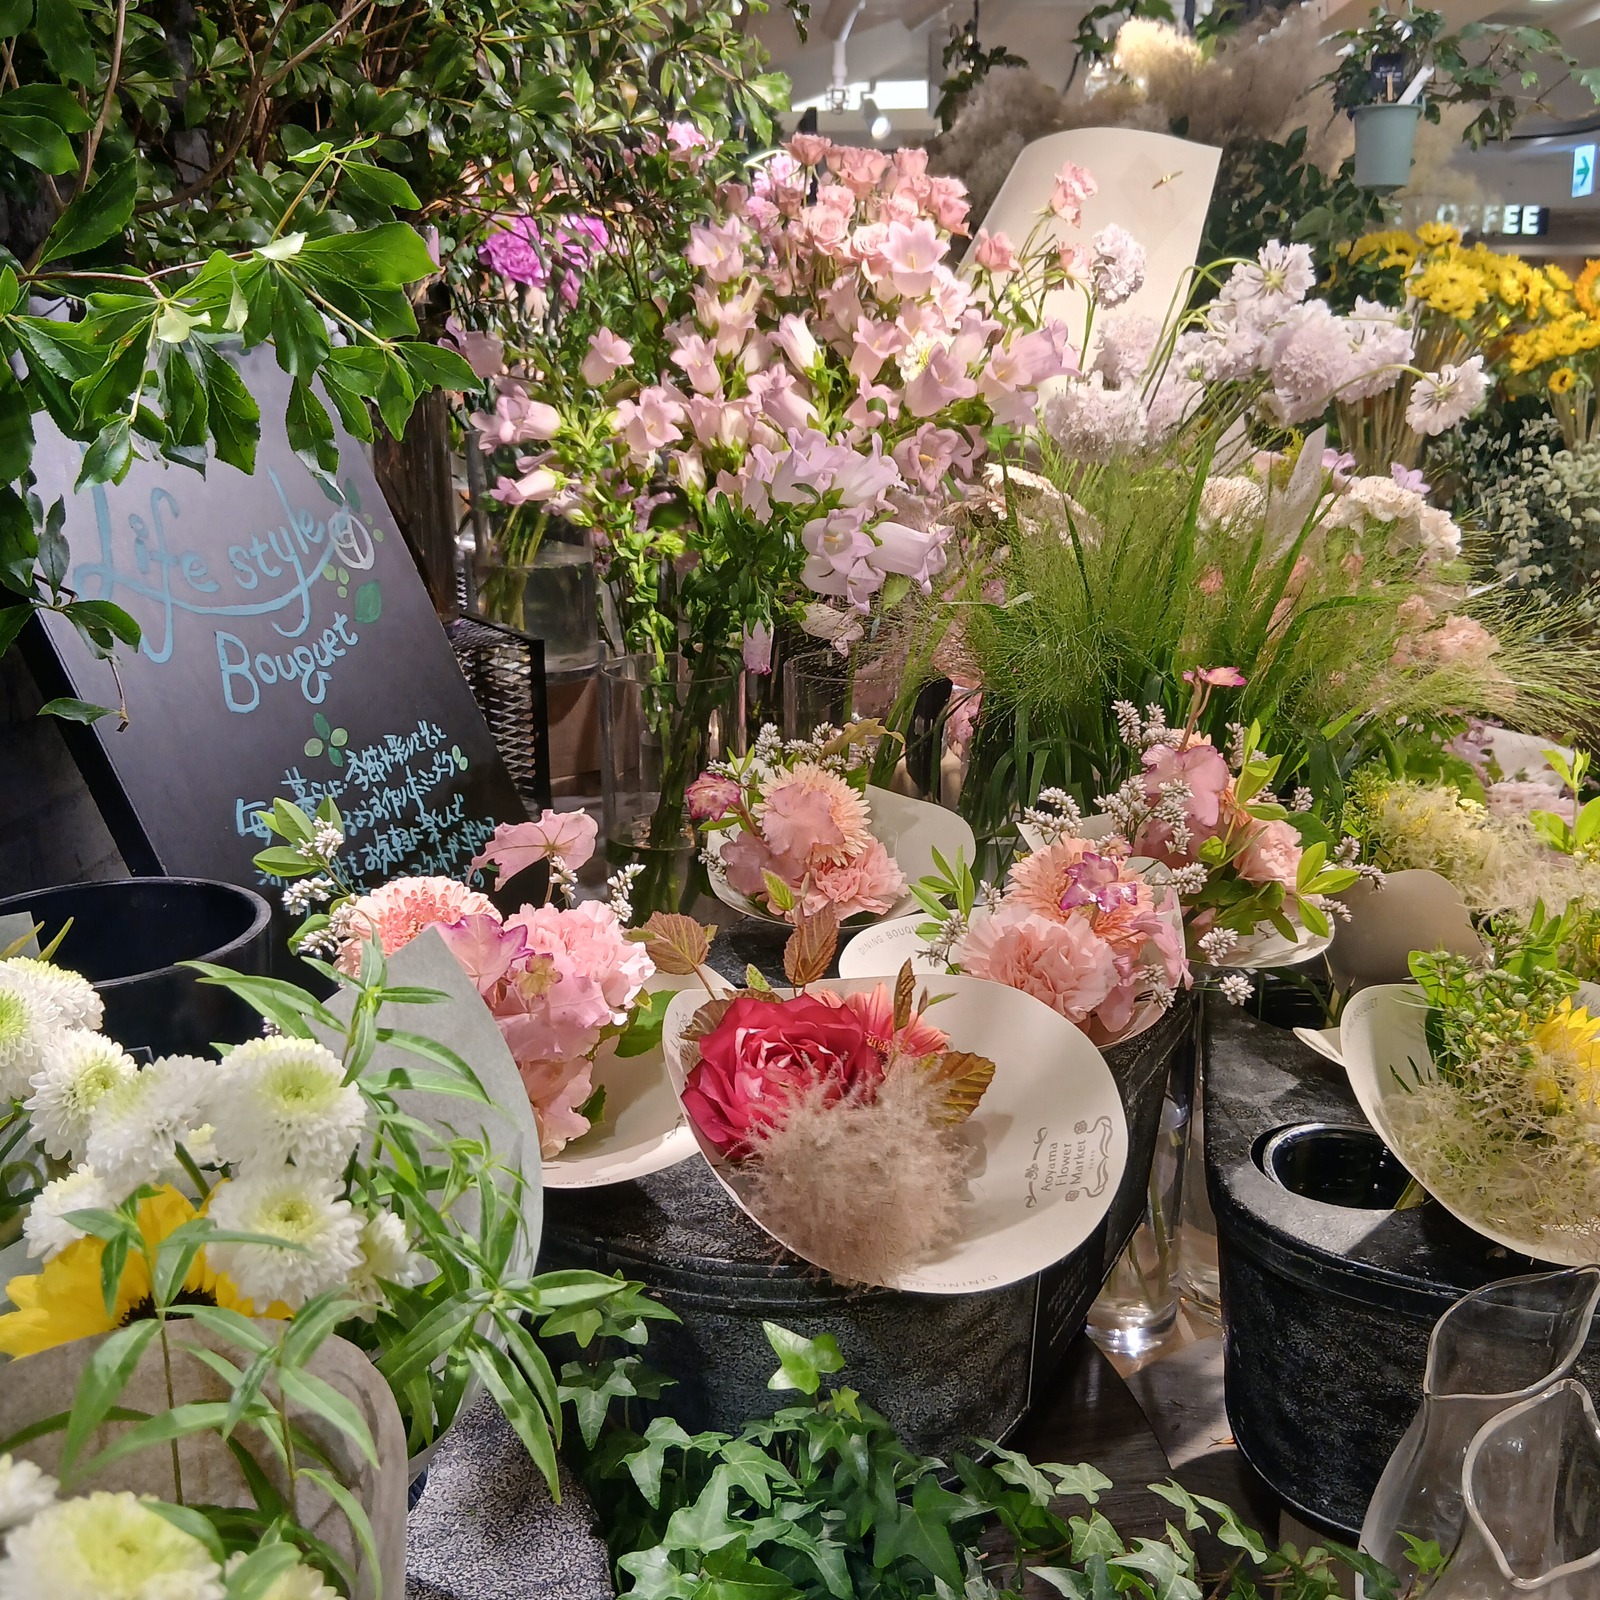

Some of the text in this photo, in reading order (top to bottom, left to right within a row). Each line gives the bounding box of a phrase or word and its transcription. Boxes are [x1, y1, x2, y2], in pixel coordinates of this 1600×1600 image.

[72, 443, 325, 664] Life style
[858, 924, 919, 956] DINING BOUQU
[1041, 1142, 1058, 1191] Aoyama
[1055, 1143, 1072, 1187] Flower
[1070, 1139, 1086, 1185] Market
[936, 1274, 999, 1288] DINING
